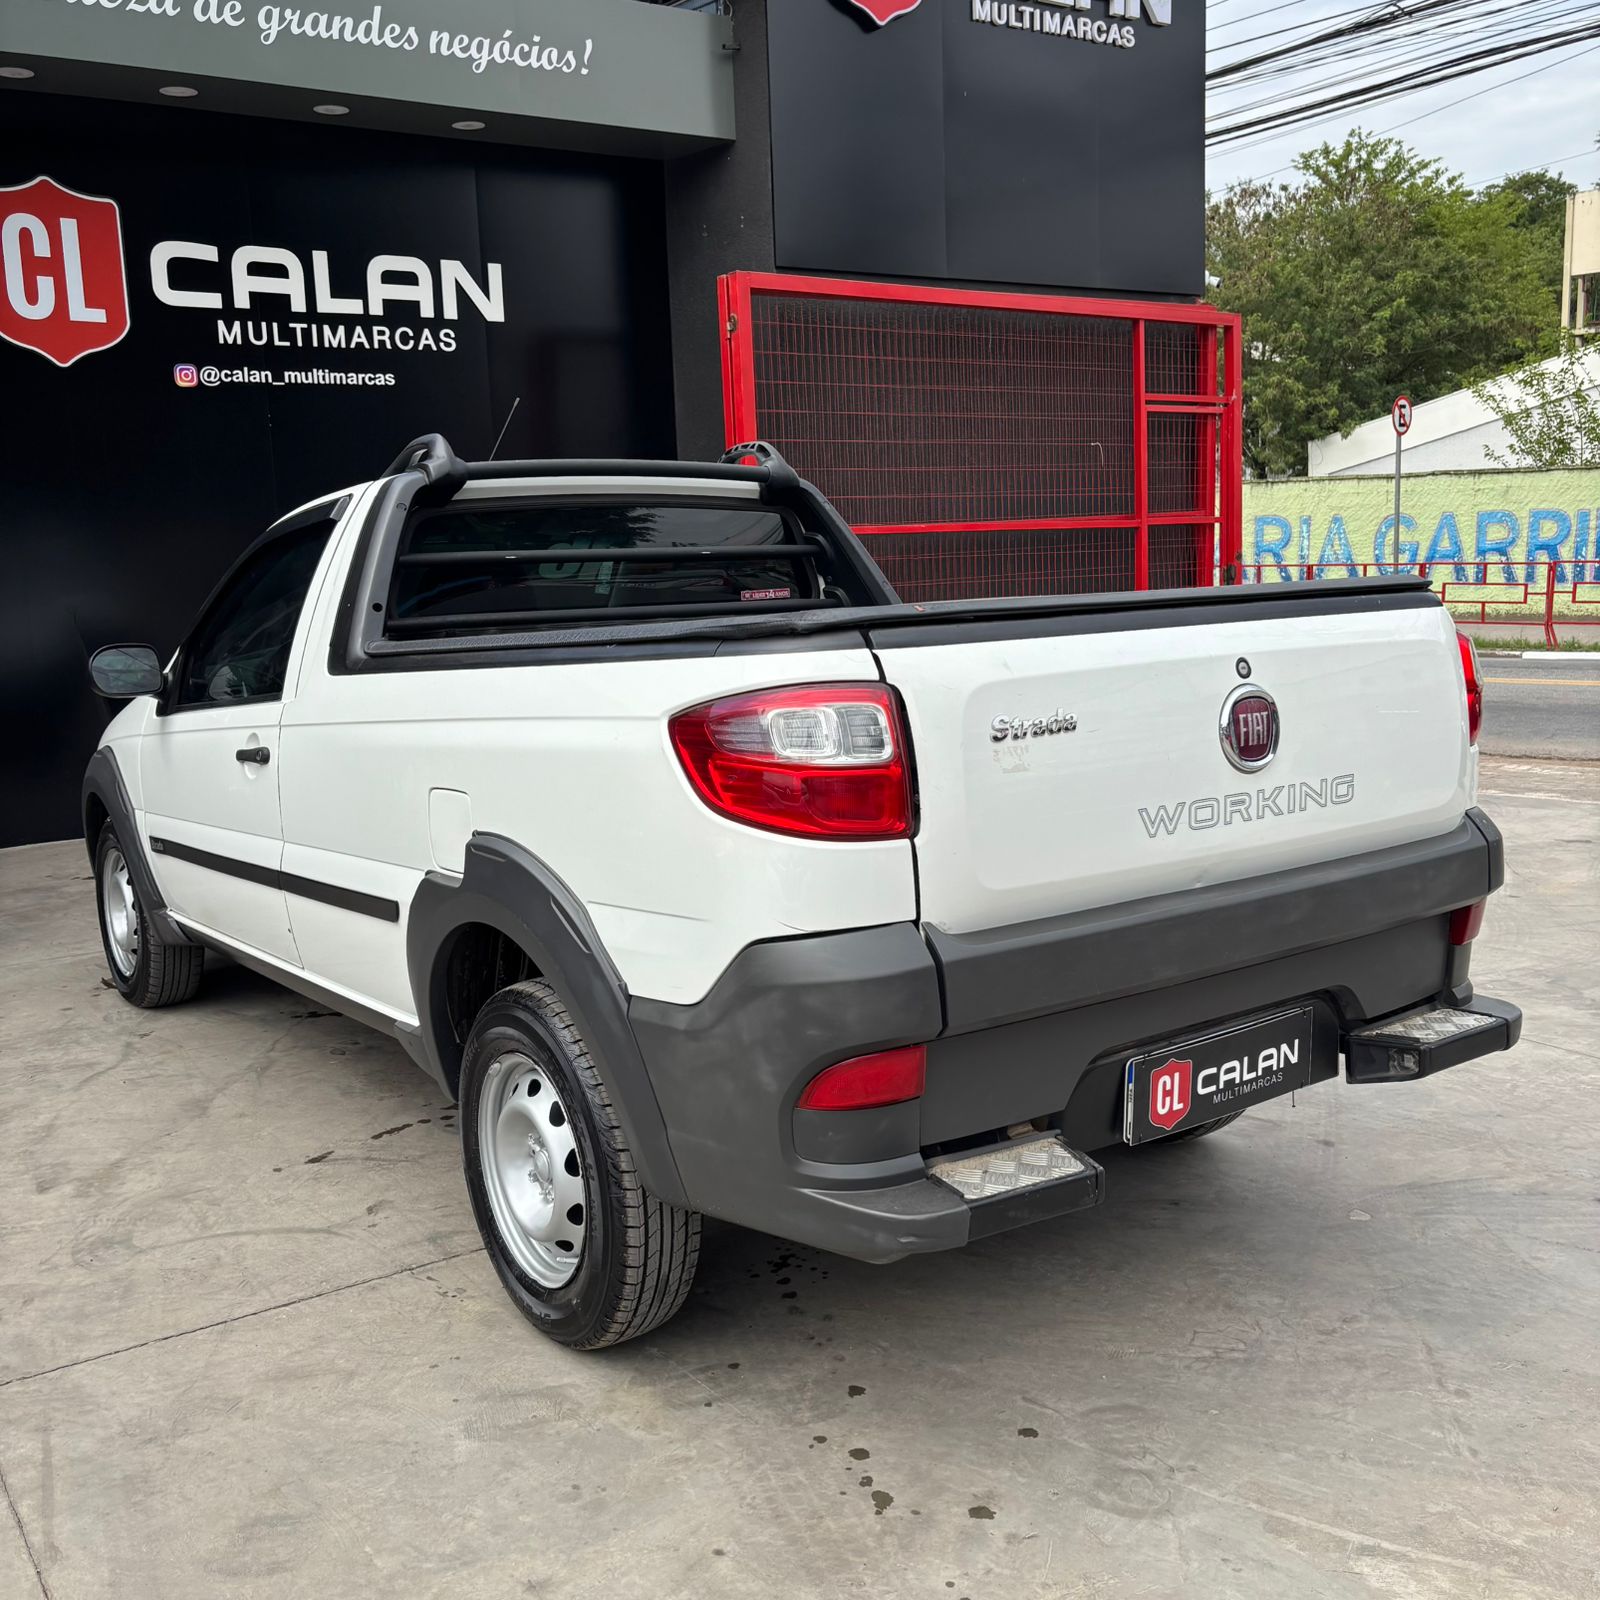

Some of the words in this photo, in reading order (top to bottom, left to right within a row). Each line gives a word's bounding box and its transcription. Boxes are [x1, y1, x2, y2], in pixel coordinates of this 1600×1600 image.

[193, 0, 246, 27] de
[257, 5, 419, 51] grandes
[429, 29, 593, 75] negócios!
[972, 0, 1136, 49] MULTIMARCAS
[1, 212, 107, 324] CL
[149, 240, 505, 323] CALAN
[217, 319, 457, 352] MULTIMARCAS
[199, 365, 396, 387] @calan_multimarcas
[1242, 514, 1359, 581] RIA
[1373, 508, 1600, 583] GARRI
[989, 706, 1078, 743] Strada
[1238, 710, 1270, 748] FIAT
[1138, 773, 1355, 839] WORKING
[1197, 1038, 1300, 1095] CALAN
[1212, 1072, 1284, 1105] MULTIMARCAS
[1156, 1071, 1184, 1116] CL
